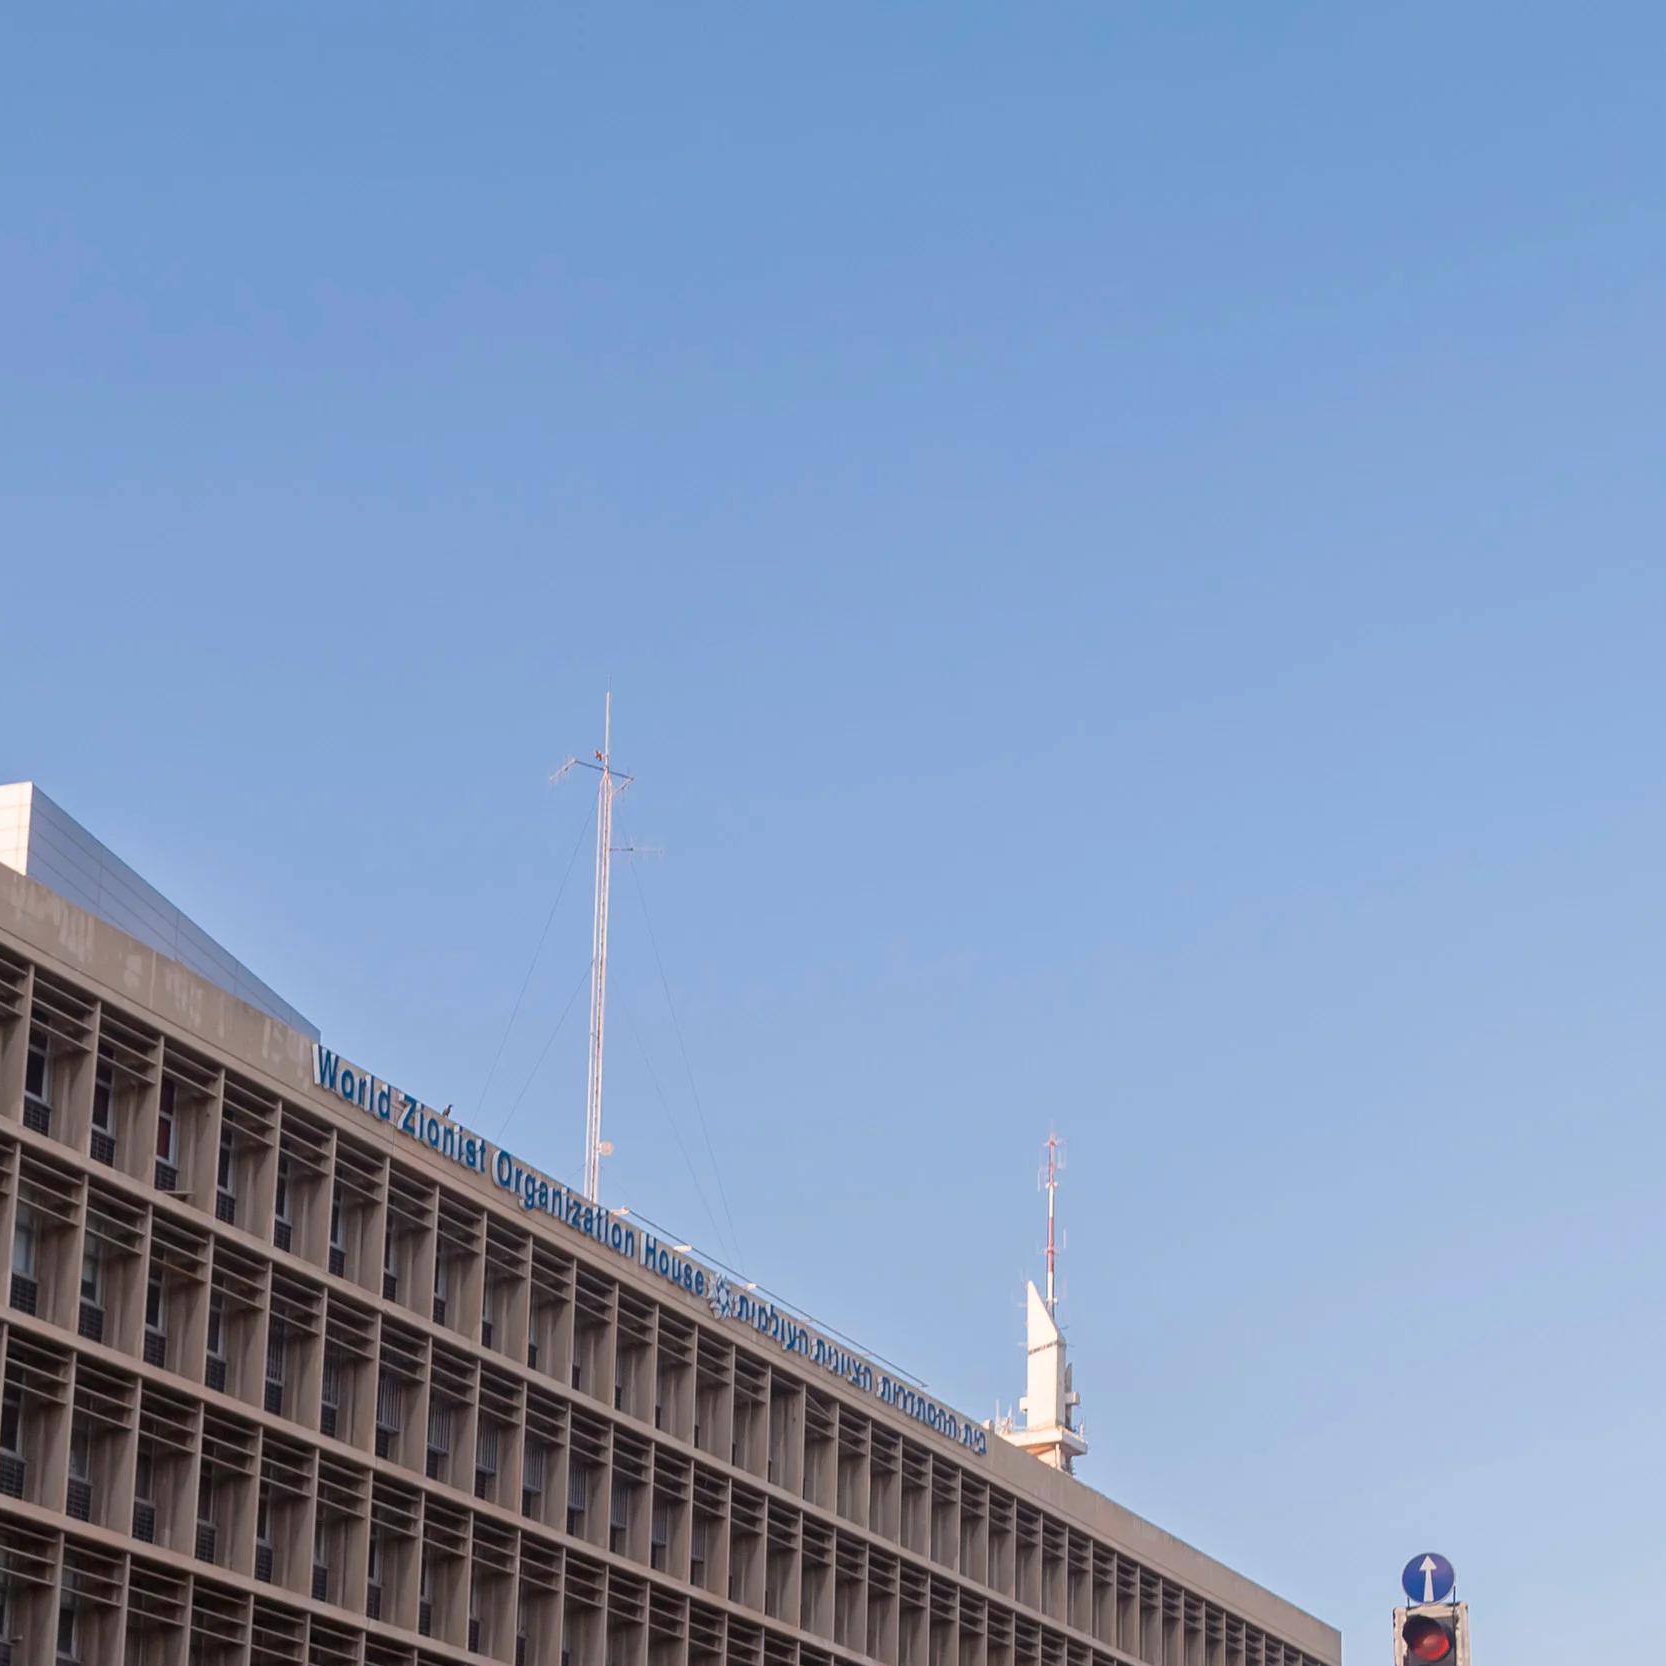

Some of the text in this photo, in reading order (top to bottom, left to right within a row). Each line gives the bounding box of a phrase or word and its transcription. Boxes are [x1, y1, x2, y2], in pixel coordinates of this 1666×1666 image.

[313, 1043, 704, 1297] World Zionist Organization House
[810, 1338, 873, 1392] הציונית
[876, 1375, 956, 1439] ההסתדרות
[958, 1423, 987, 1454] בית
